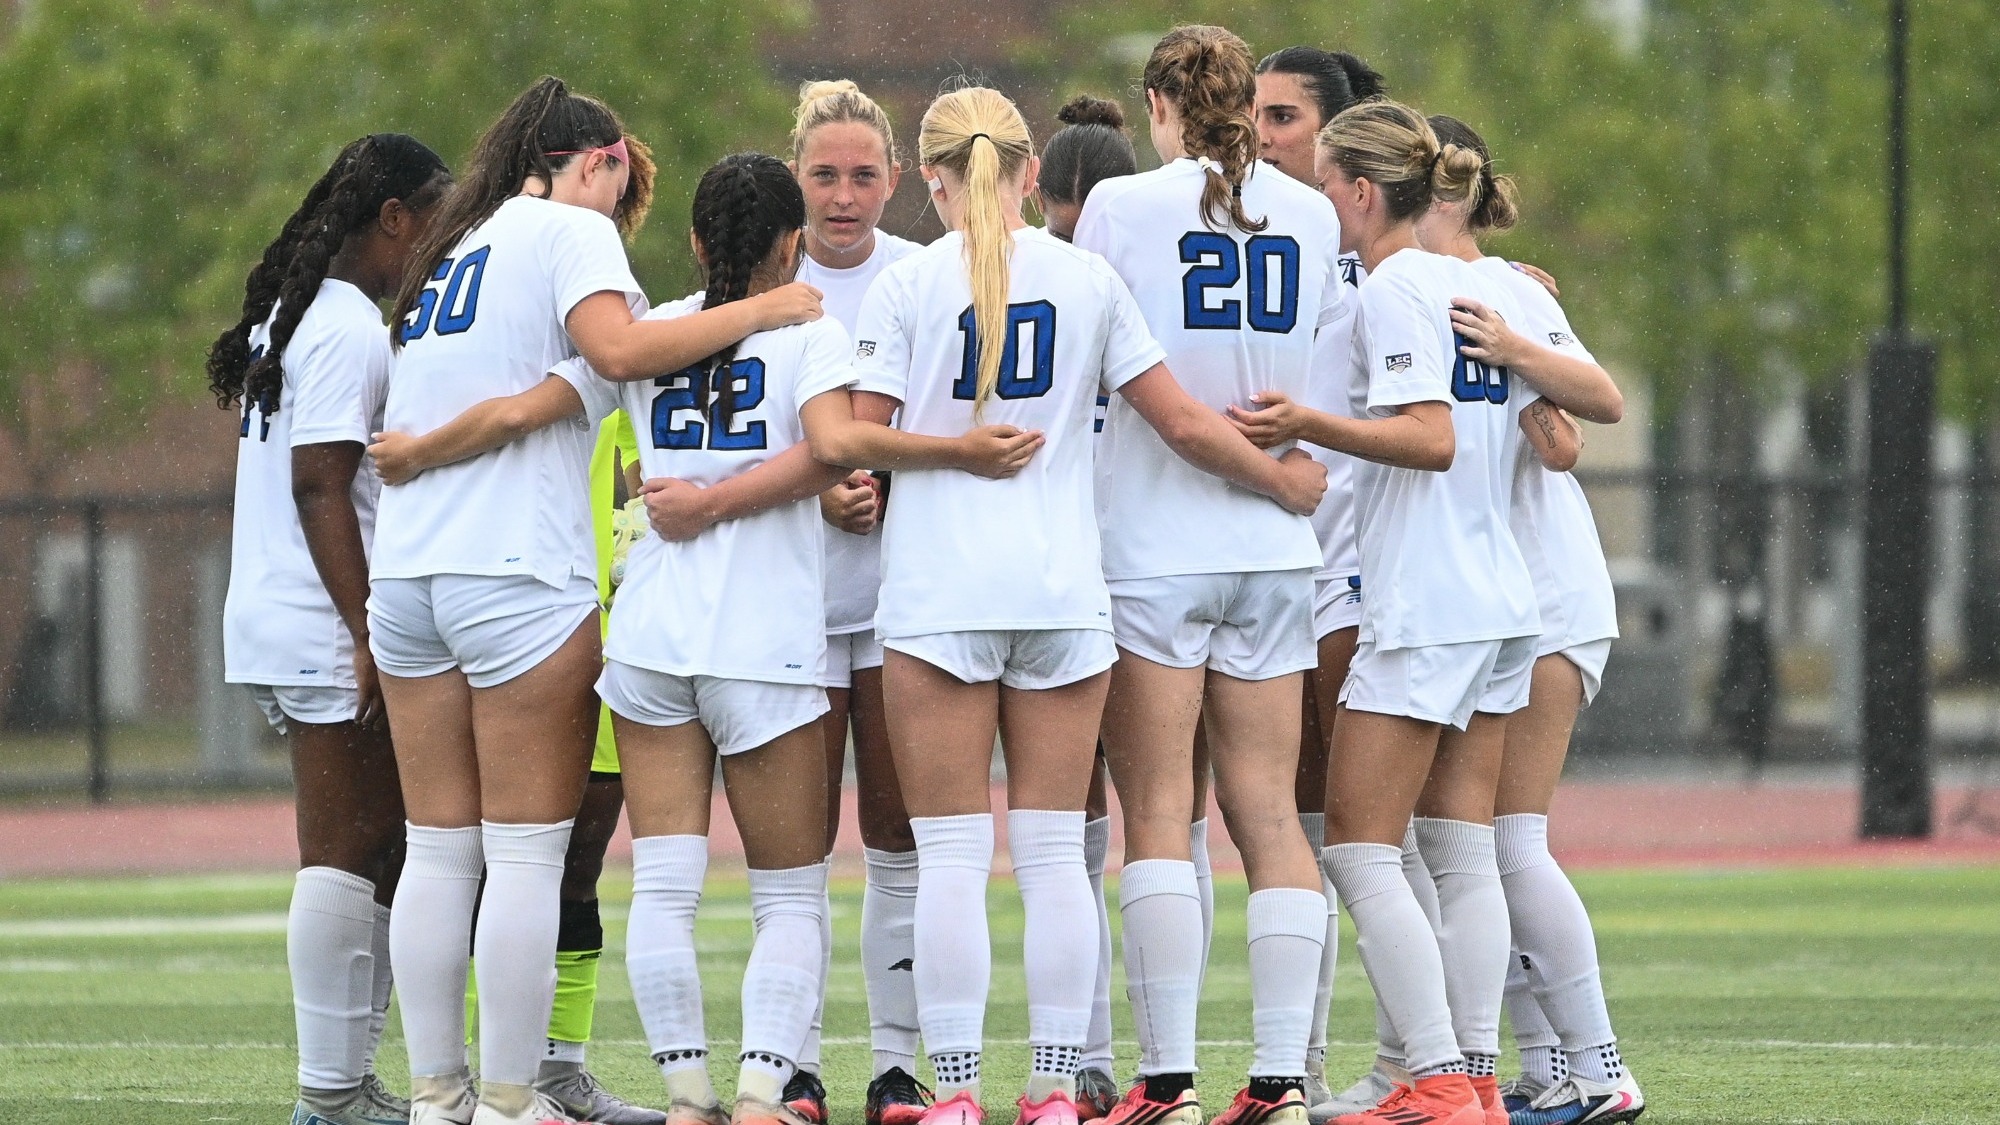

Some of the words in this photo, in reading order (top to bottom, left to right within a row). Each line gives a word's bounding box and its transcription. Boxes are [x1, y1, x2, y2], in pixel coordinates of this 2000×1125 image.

[400, 244, 491, 348] 50
[1178, 231, 1300, 334] 20
[952, 299, 1056, 400] 10
[1387, 355, 1411, 367] LEC
[651, 357, 767, 450] 22
